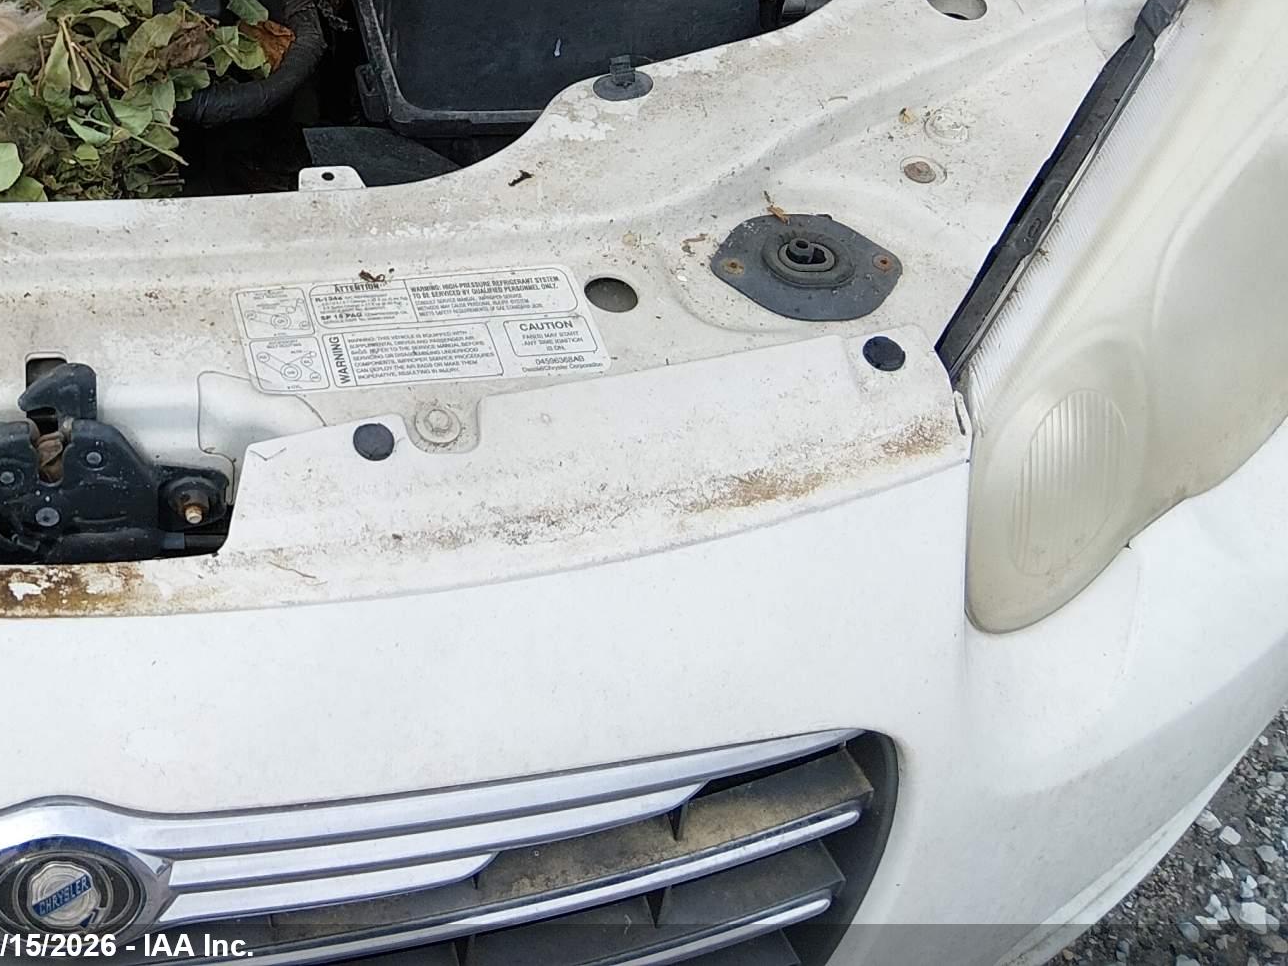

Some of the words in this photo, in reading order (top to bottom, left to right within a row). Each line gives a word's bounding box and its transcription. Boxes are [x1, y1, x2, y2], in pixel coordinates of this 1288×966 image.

[334, 283, 380, 293] ATTENTION
[519, 320, 573, 331] CAUTION
[328, 336, 351, 384] WARNING
[39, 876, 88, 915] CHRYSLER
